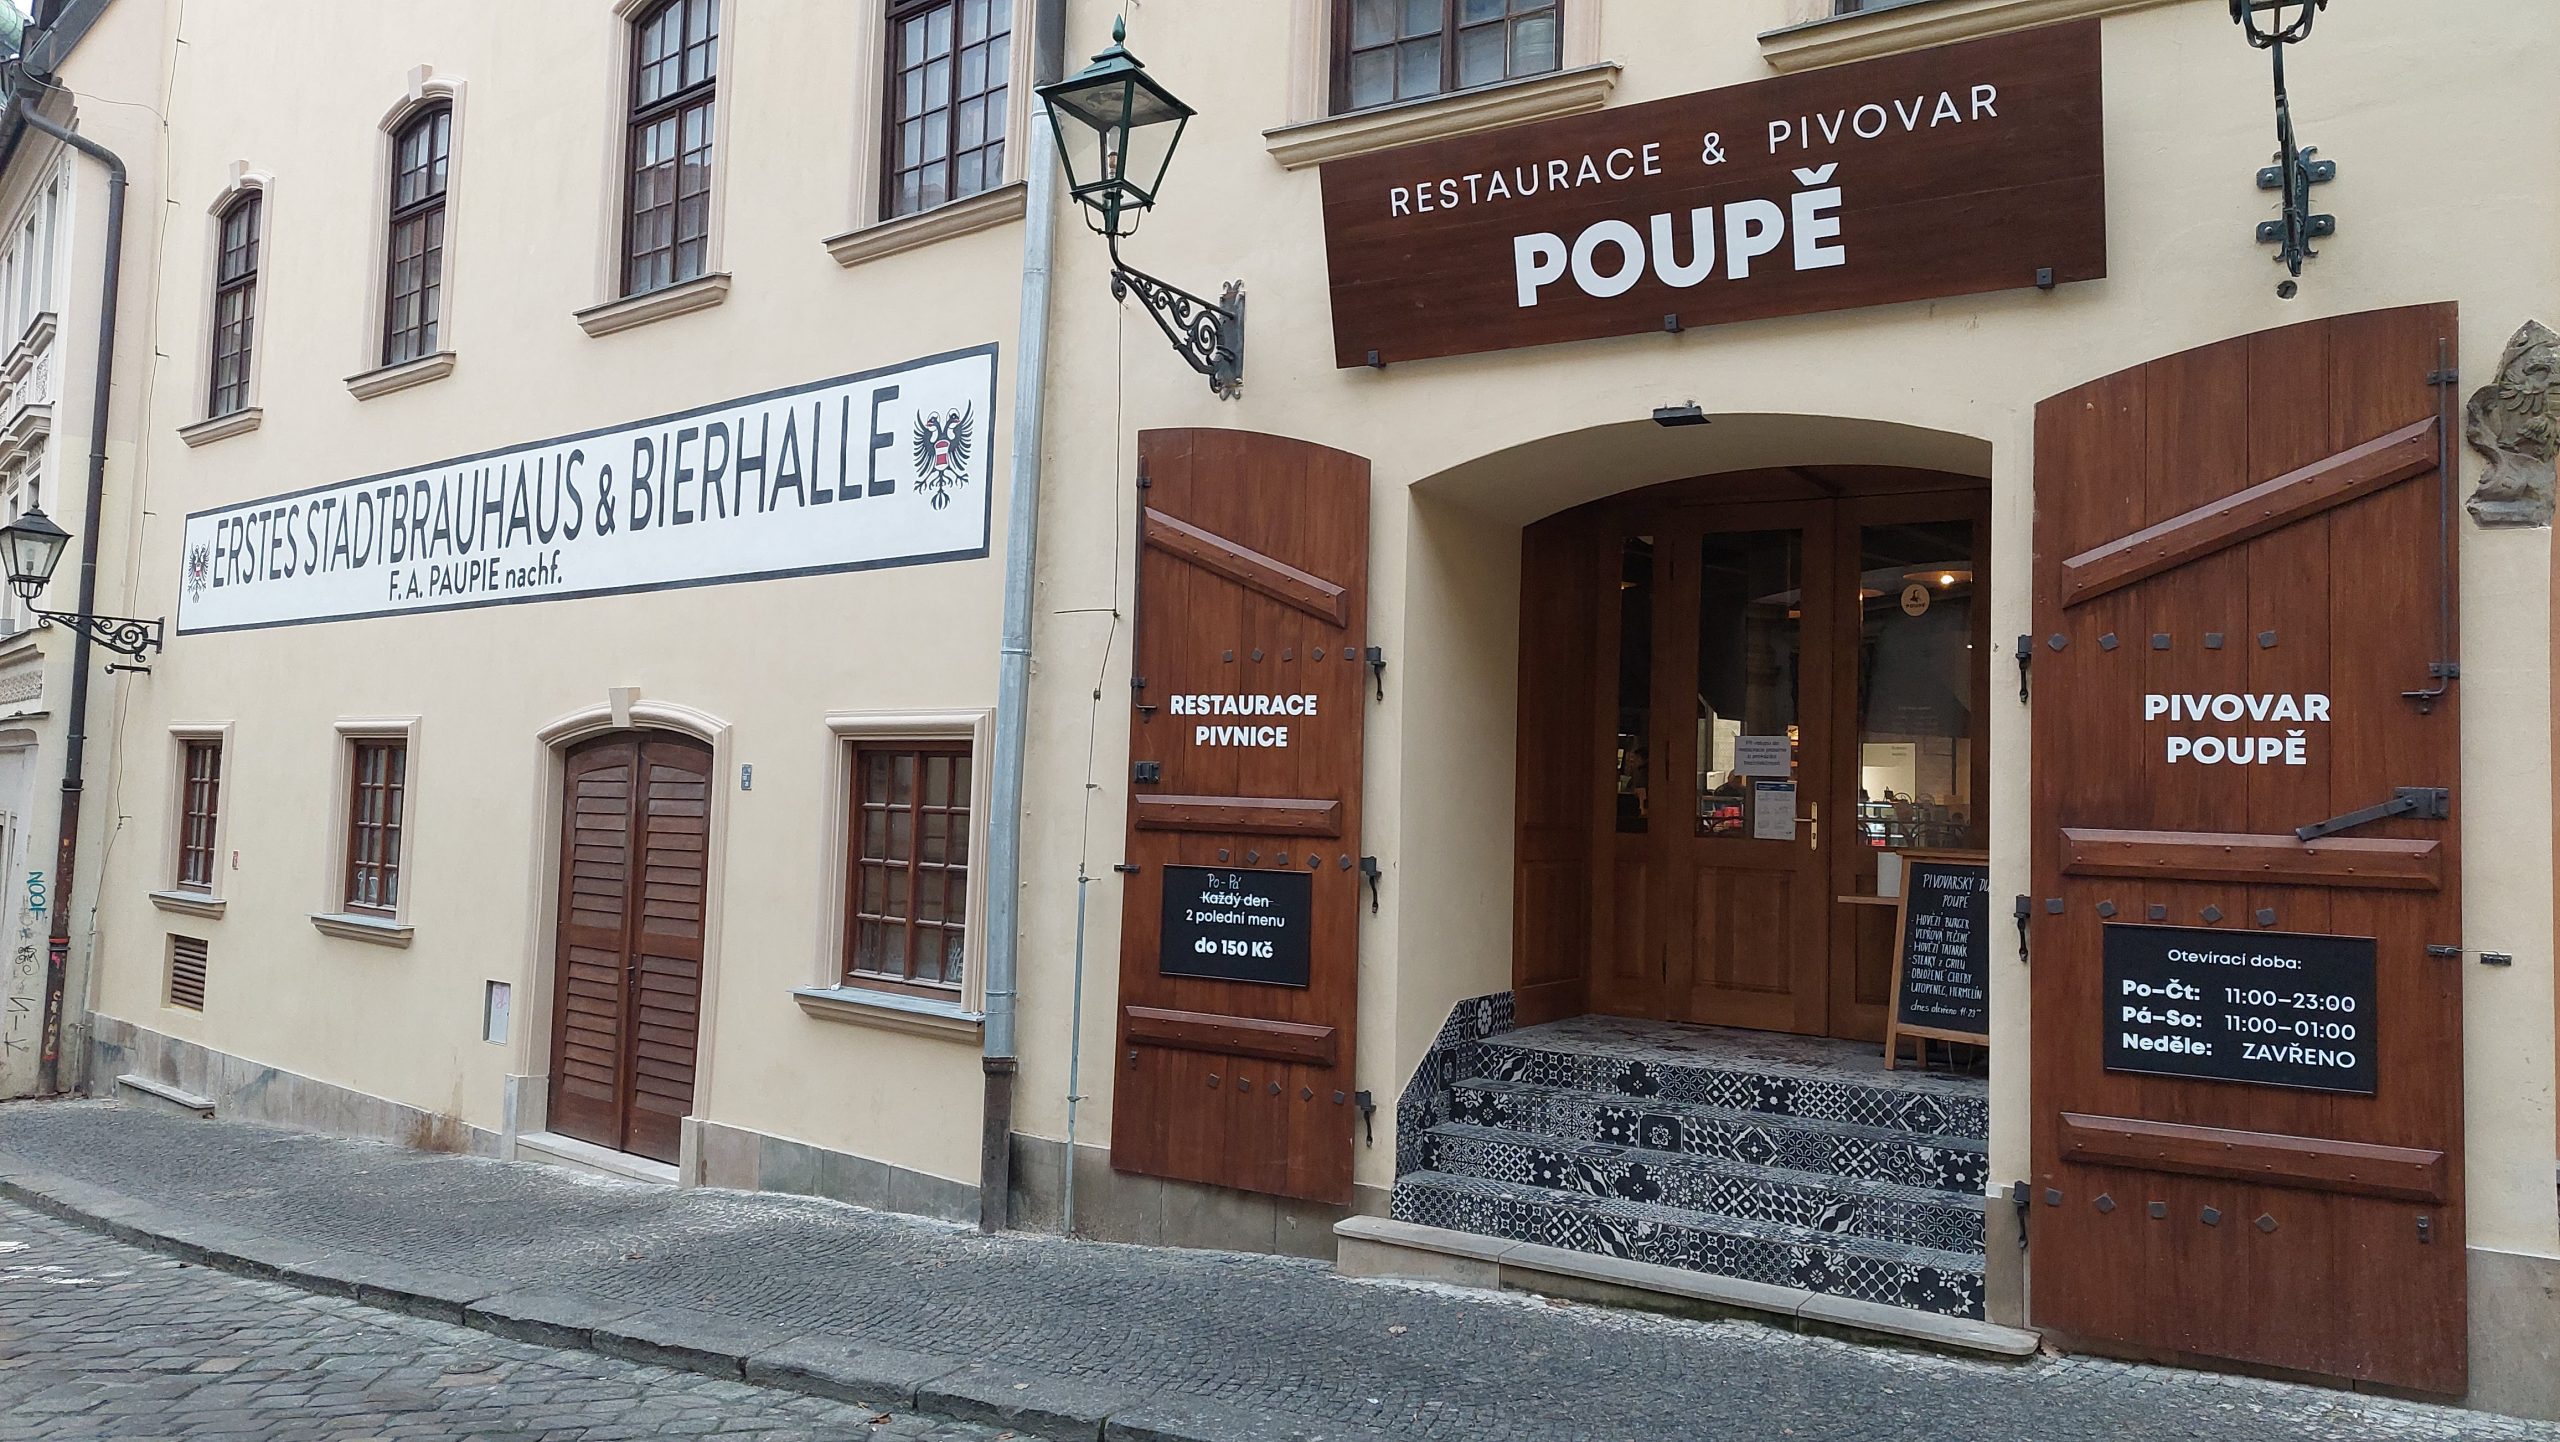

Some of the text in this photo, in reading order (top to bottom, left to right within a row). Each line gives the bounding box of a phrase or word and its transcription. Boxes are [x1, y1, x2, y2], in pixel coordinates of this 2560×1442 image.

[1389, 83, 1999, 218] RESTAURACE & PIVOVAR
[1513, 162, 1847, 308] POUPĚ
[213, 384, 900, 588] ERSTES STADTBRAUHAUS & BIERHALLE
[389, 549, 562, 601] F. A. PAUPIE nachf.
[1170, 694, 1318, 716] RESTAURACE
[2145, 693, 2331, 722] PIVOVAR
[1195, 725, 1288, 747] PIVNICE
[2167, 729, 2307, 765] POUPĚ
[1922, 871, 1975, 890] PIVOVARSKÝ
[1202, 891, 1270, 908] Každý den
[1186, 909, 1285, 928] 2 polední menu
[1194, 937, 1274, 959] do 150 Kč
[2167, 949, 2302, 970] Otevírací doba:
[2122, 1032, 2356, 1069] Neděle: ZAVŘENO
